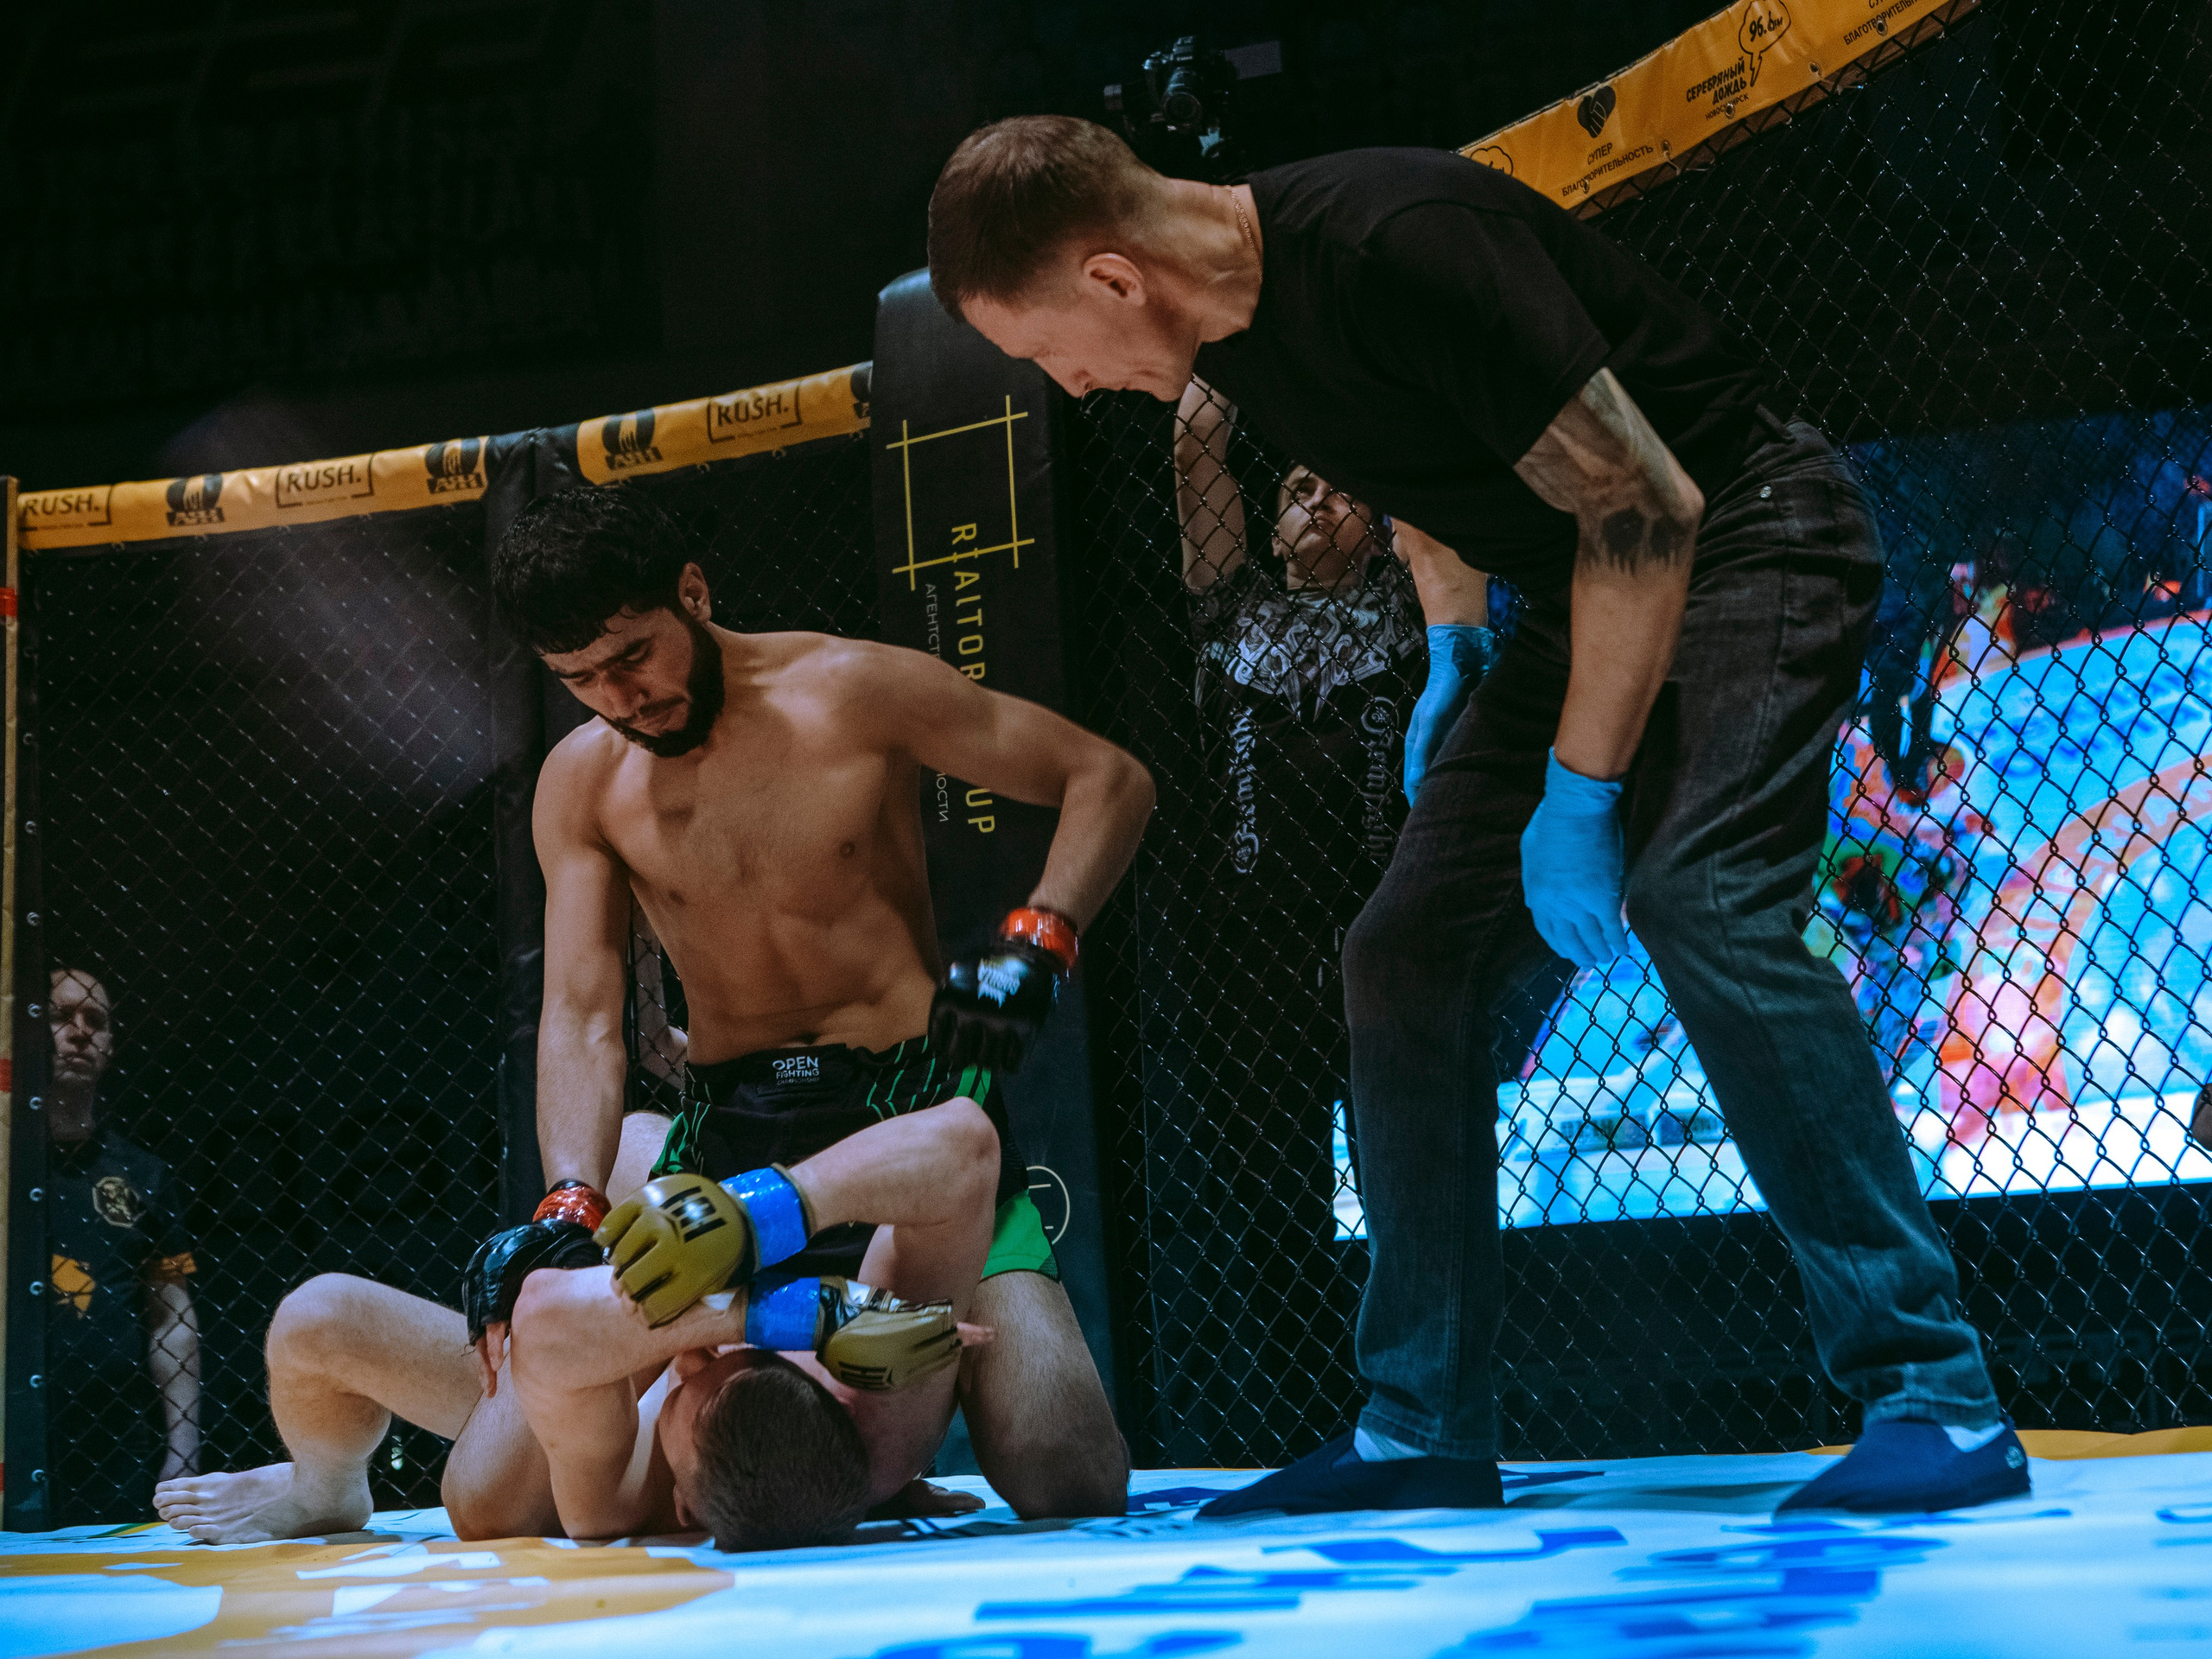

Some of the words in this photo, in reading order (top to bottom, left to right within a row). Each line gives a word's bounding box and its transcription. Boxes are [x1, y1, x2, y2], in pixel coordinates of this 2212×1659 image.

[1687, 56, 1745, 102] СЕРЕБРЯНЫЙ
[1713, 77, 1746, 105] ДОЖДЬ
[1706, 93, 1749, 120] НОВОСИРСК
[1587, 143, 1613, 165] СУПЕР
[717, 393, 789, 427] RUSH.
[286, 464, 361, 493] RUSH.
[925, 583, 940, 658] АГЕНТСТ
[772, 1055, 819, 1071] OPEN
[776, 1068, 820, 1079] FIGHTING
